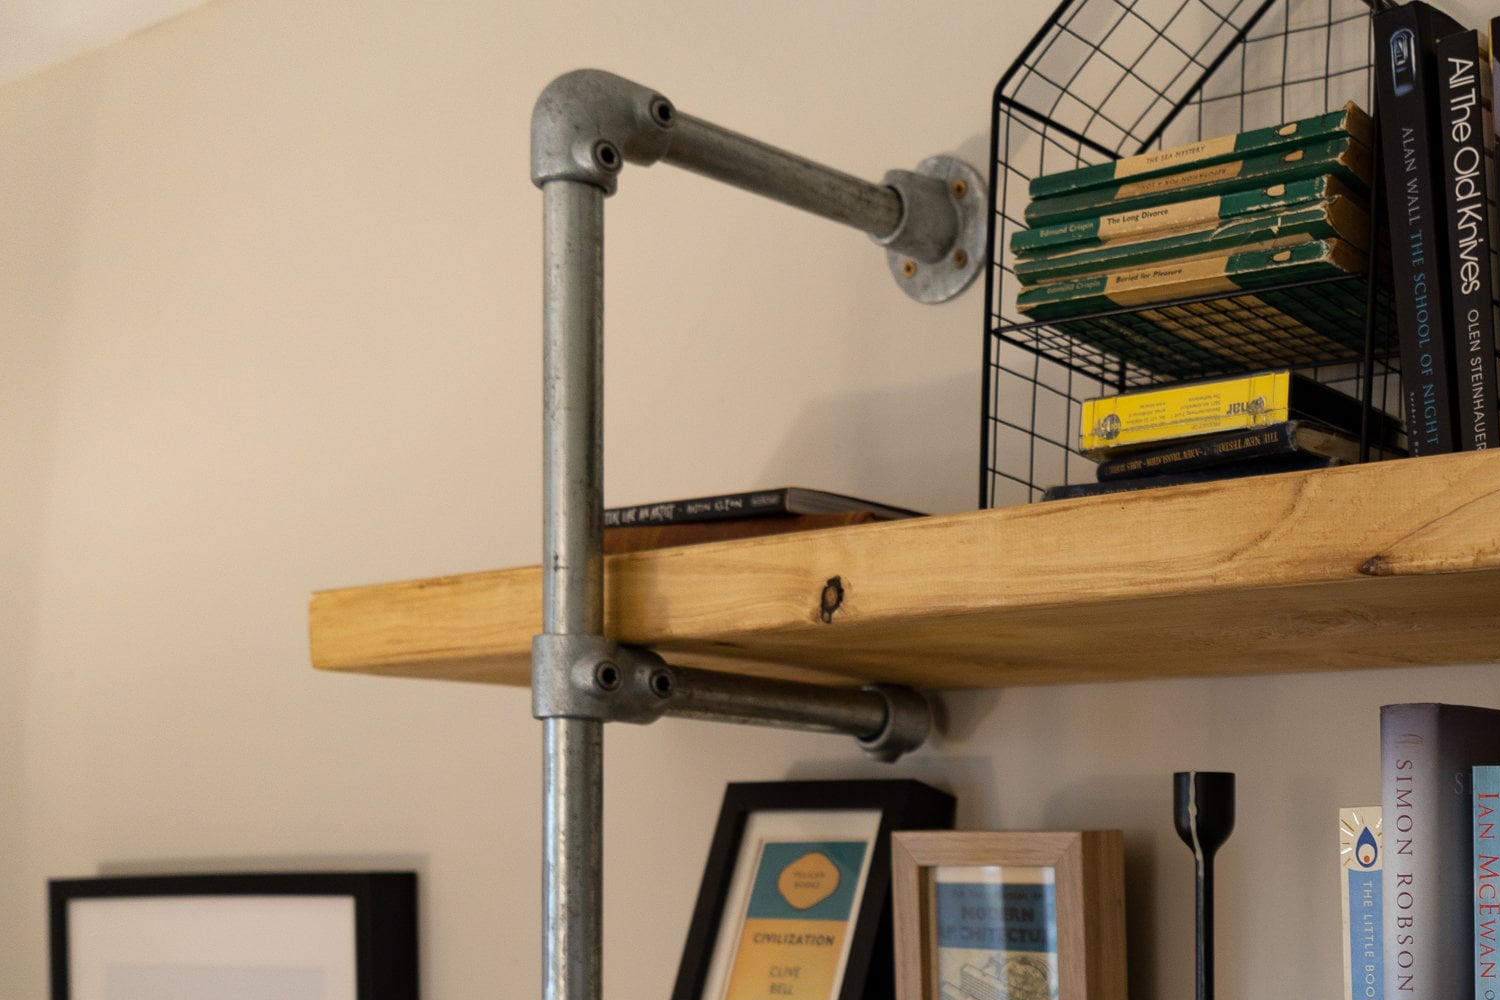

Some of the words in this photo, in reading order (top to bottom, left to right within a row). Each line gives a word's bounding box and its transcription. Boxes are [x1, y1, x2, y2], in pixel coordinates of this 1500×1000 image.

[1448, 57, 1474, 93] All
[1450, 94, 1477, 143] The
[1402, 127, 1417, 173] ALAN
[1453, 148, 1480, 202] Old
[1039, 226, 1068, 238] Edmund
[1069, 222, 1094, 233] Crispin
[1107, 217, 1120, 225] The
[1122, 214, 1140, 223] Long
[1141, 208, 1169, 219] Divorce
[1407, 178, 1421, 225] WALL
[1411, 231, 1425, 266] THE
[1457, 204, 1483, 295] Knives
[1116, 273, 1139, 283] Buried
[1152, 268, 1183, 278] Pleasure
[1414, 272, 1430, 345] SCHOOL
[1467, 309, 1482, 354] OLEN
[1420, 353, 1433, 377] OF
[1423, 382, 1440, 446] NIGHT
[1471, 359, 1488, 451] STEINHAUER
[1395, 758, 1414, 858] SIMON
[1478, 793, 1500, 839] IAN
[1363, 880, 1374, 908] THE
[752, 932, 835, 947] CIVILIZATION
[1363, 913, 1375, 958] LITTLE
[1397, 872, 1415, 994] ROBSON
